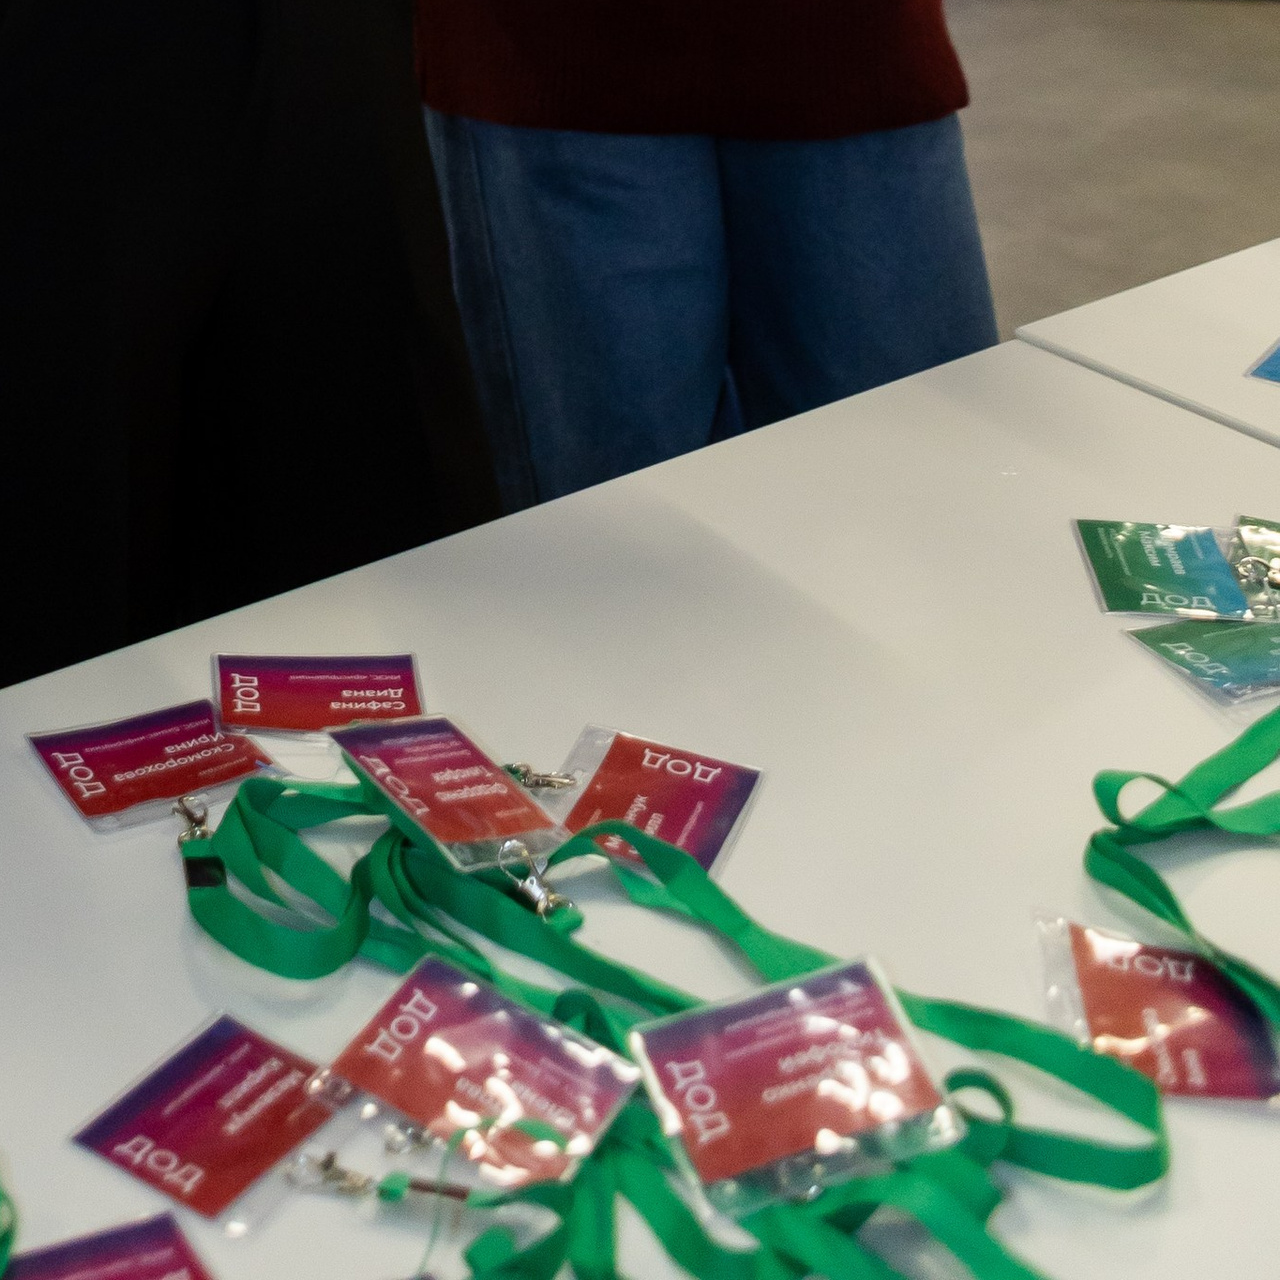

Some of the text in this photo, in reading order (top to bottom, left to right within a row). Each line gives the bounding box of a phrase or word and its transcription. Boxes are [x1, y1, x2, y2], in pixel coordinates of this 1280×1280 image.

[1140, 591, 1217, 610] ДОД
[1160, 642, 1230, 675] ДОД
[231, 673, 260, 713] ДОД
[330, 700, 406, 711] Сафина
[341, 687, 403, 699] Диана
[164, 730, 225, 754] Ирина
[52, 752, 106, 798] ДОД
[114, 743, 235, 782] Скоморохова
[642, 748, 722, 783] ДОД
[365, 989, 438, 1062] ДОД
[666, 1060, 729, 1143] ДОД
[114, 1136, 203, 1193] ДОД
